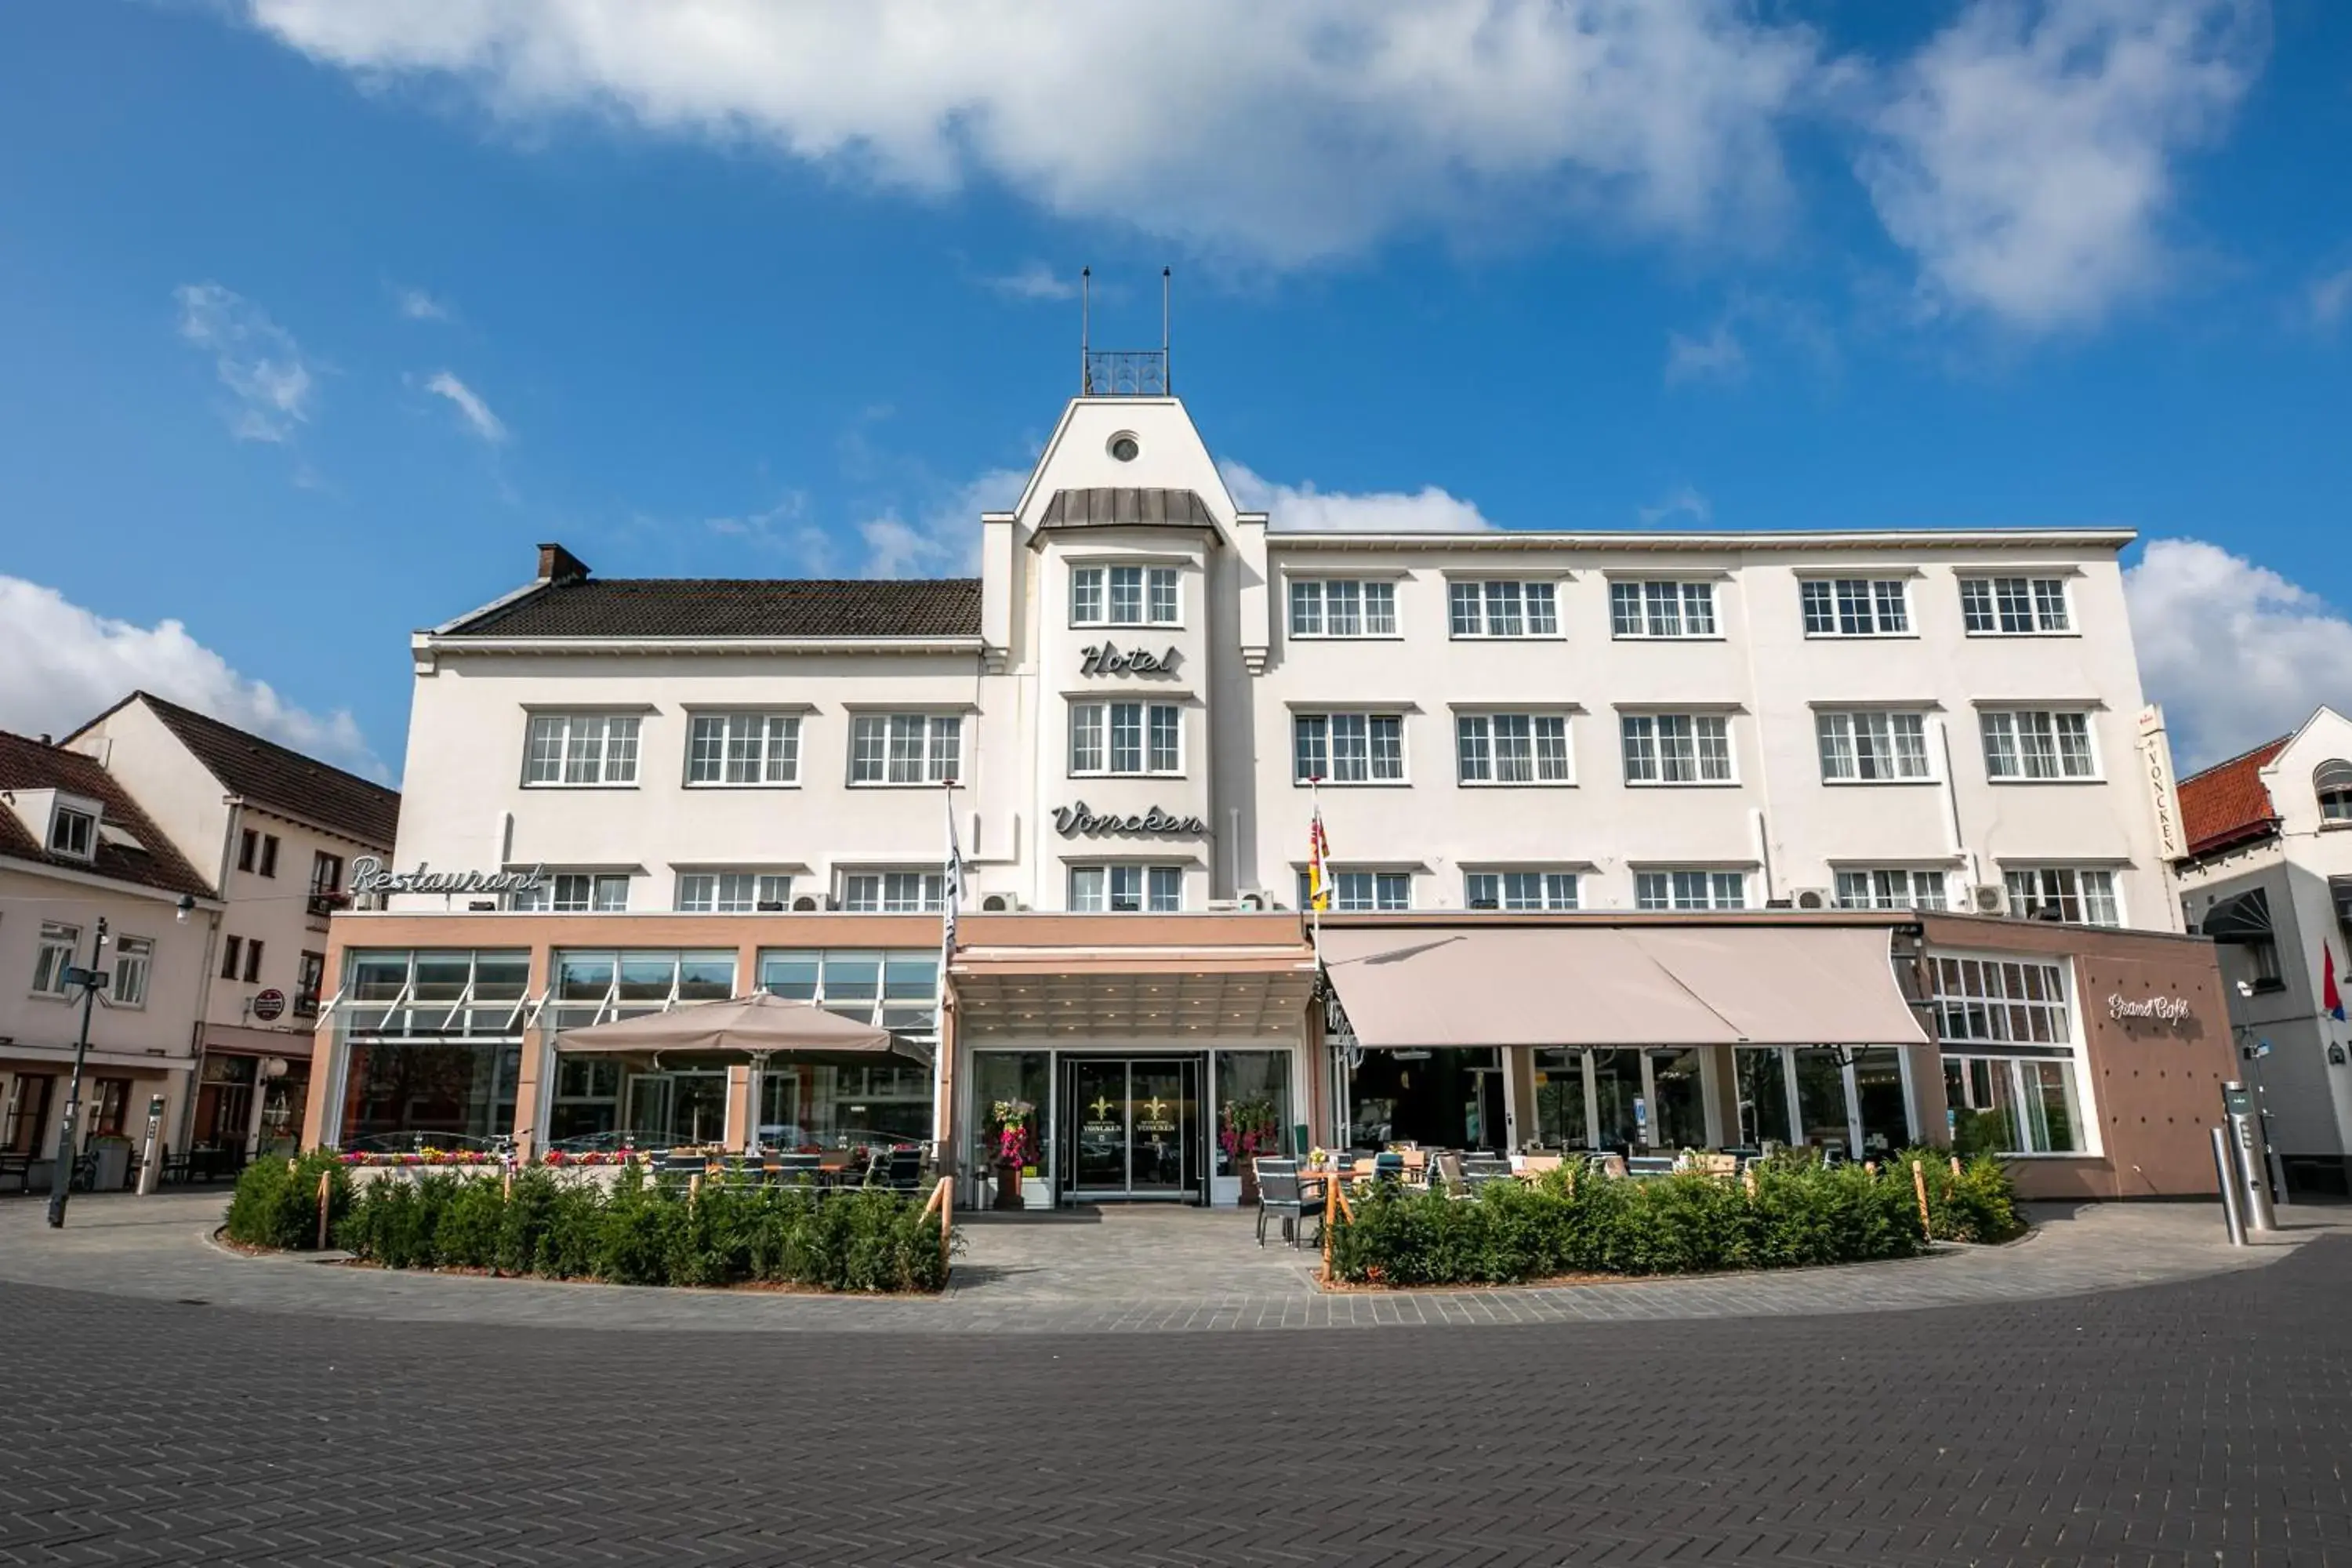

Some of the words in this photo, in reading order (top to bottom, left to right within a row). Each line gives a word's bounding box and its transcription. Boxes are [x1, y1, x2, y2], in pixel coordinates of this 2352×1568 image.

[1080, 641, 1174, 673] Hotel
[1051, 800, 1203, 833] Voncken
[2148, 750, 2175, 852] VONCKEN
[351, 855, 544, 892] Restaurant
[2107, 993, 2153, 1019] Grand
